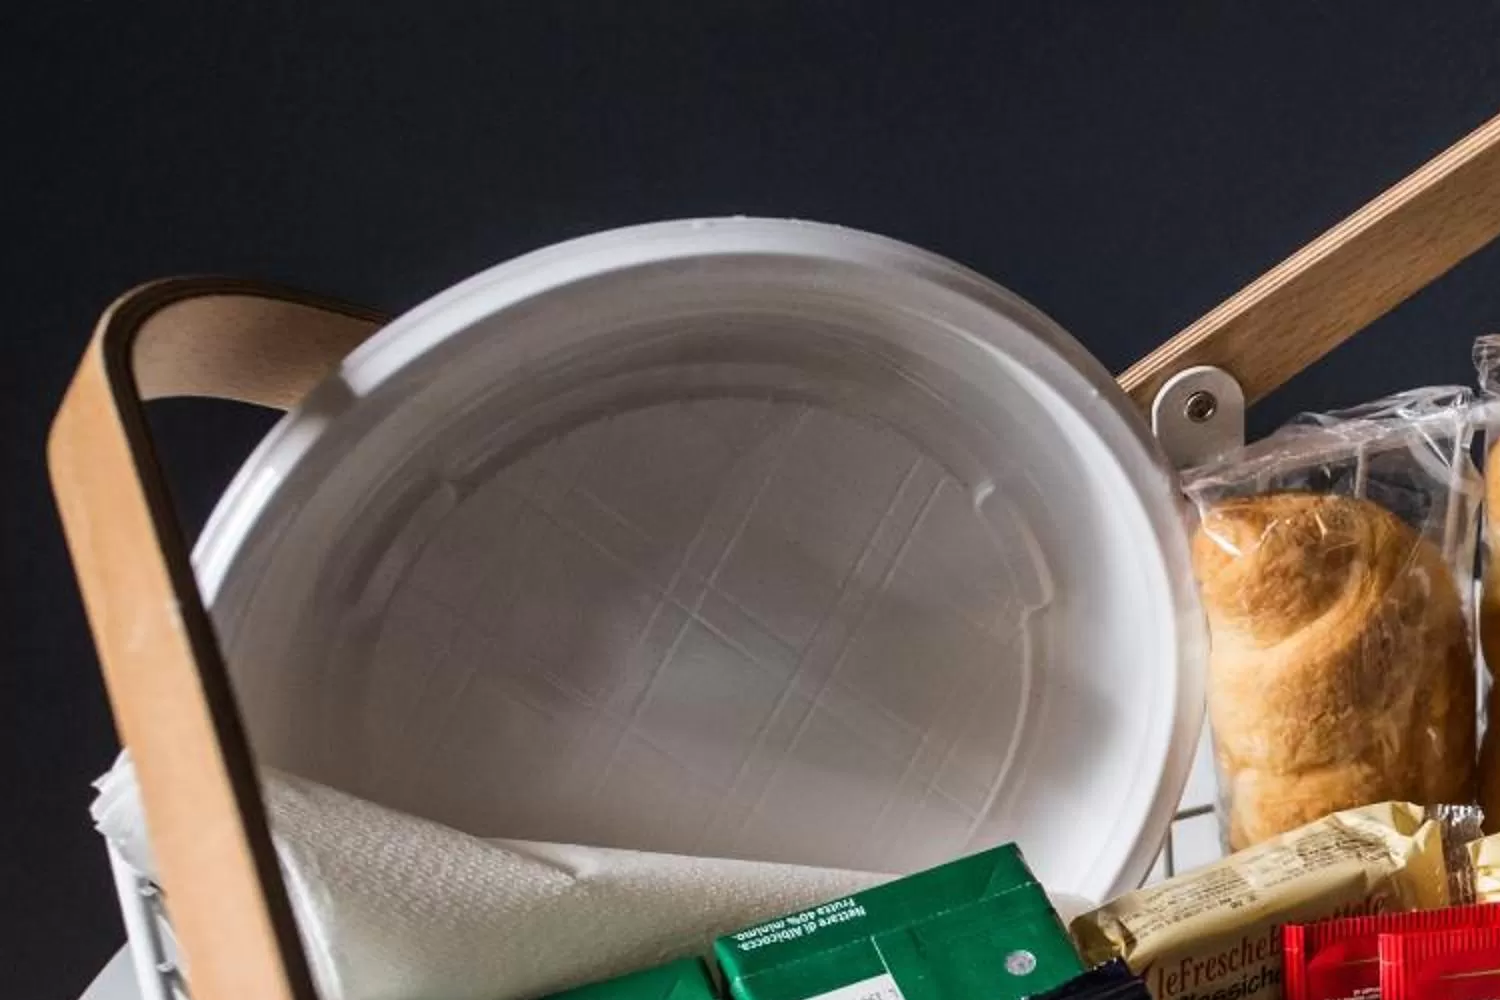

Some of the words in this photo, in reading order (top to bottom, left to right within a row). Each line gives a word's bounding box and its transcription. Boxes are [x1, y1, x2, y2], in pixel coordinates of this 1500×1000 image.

[816, 898, 855, 916] Frutta
[818, 905, 867, 928] Nettare
[803, 921, 818, 935] di
